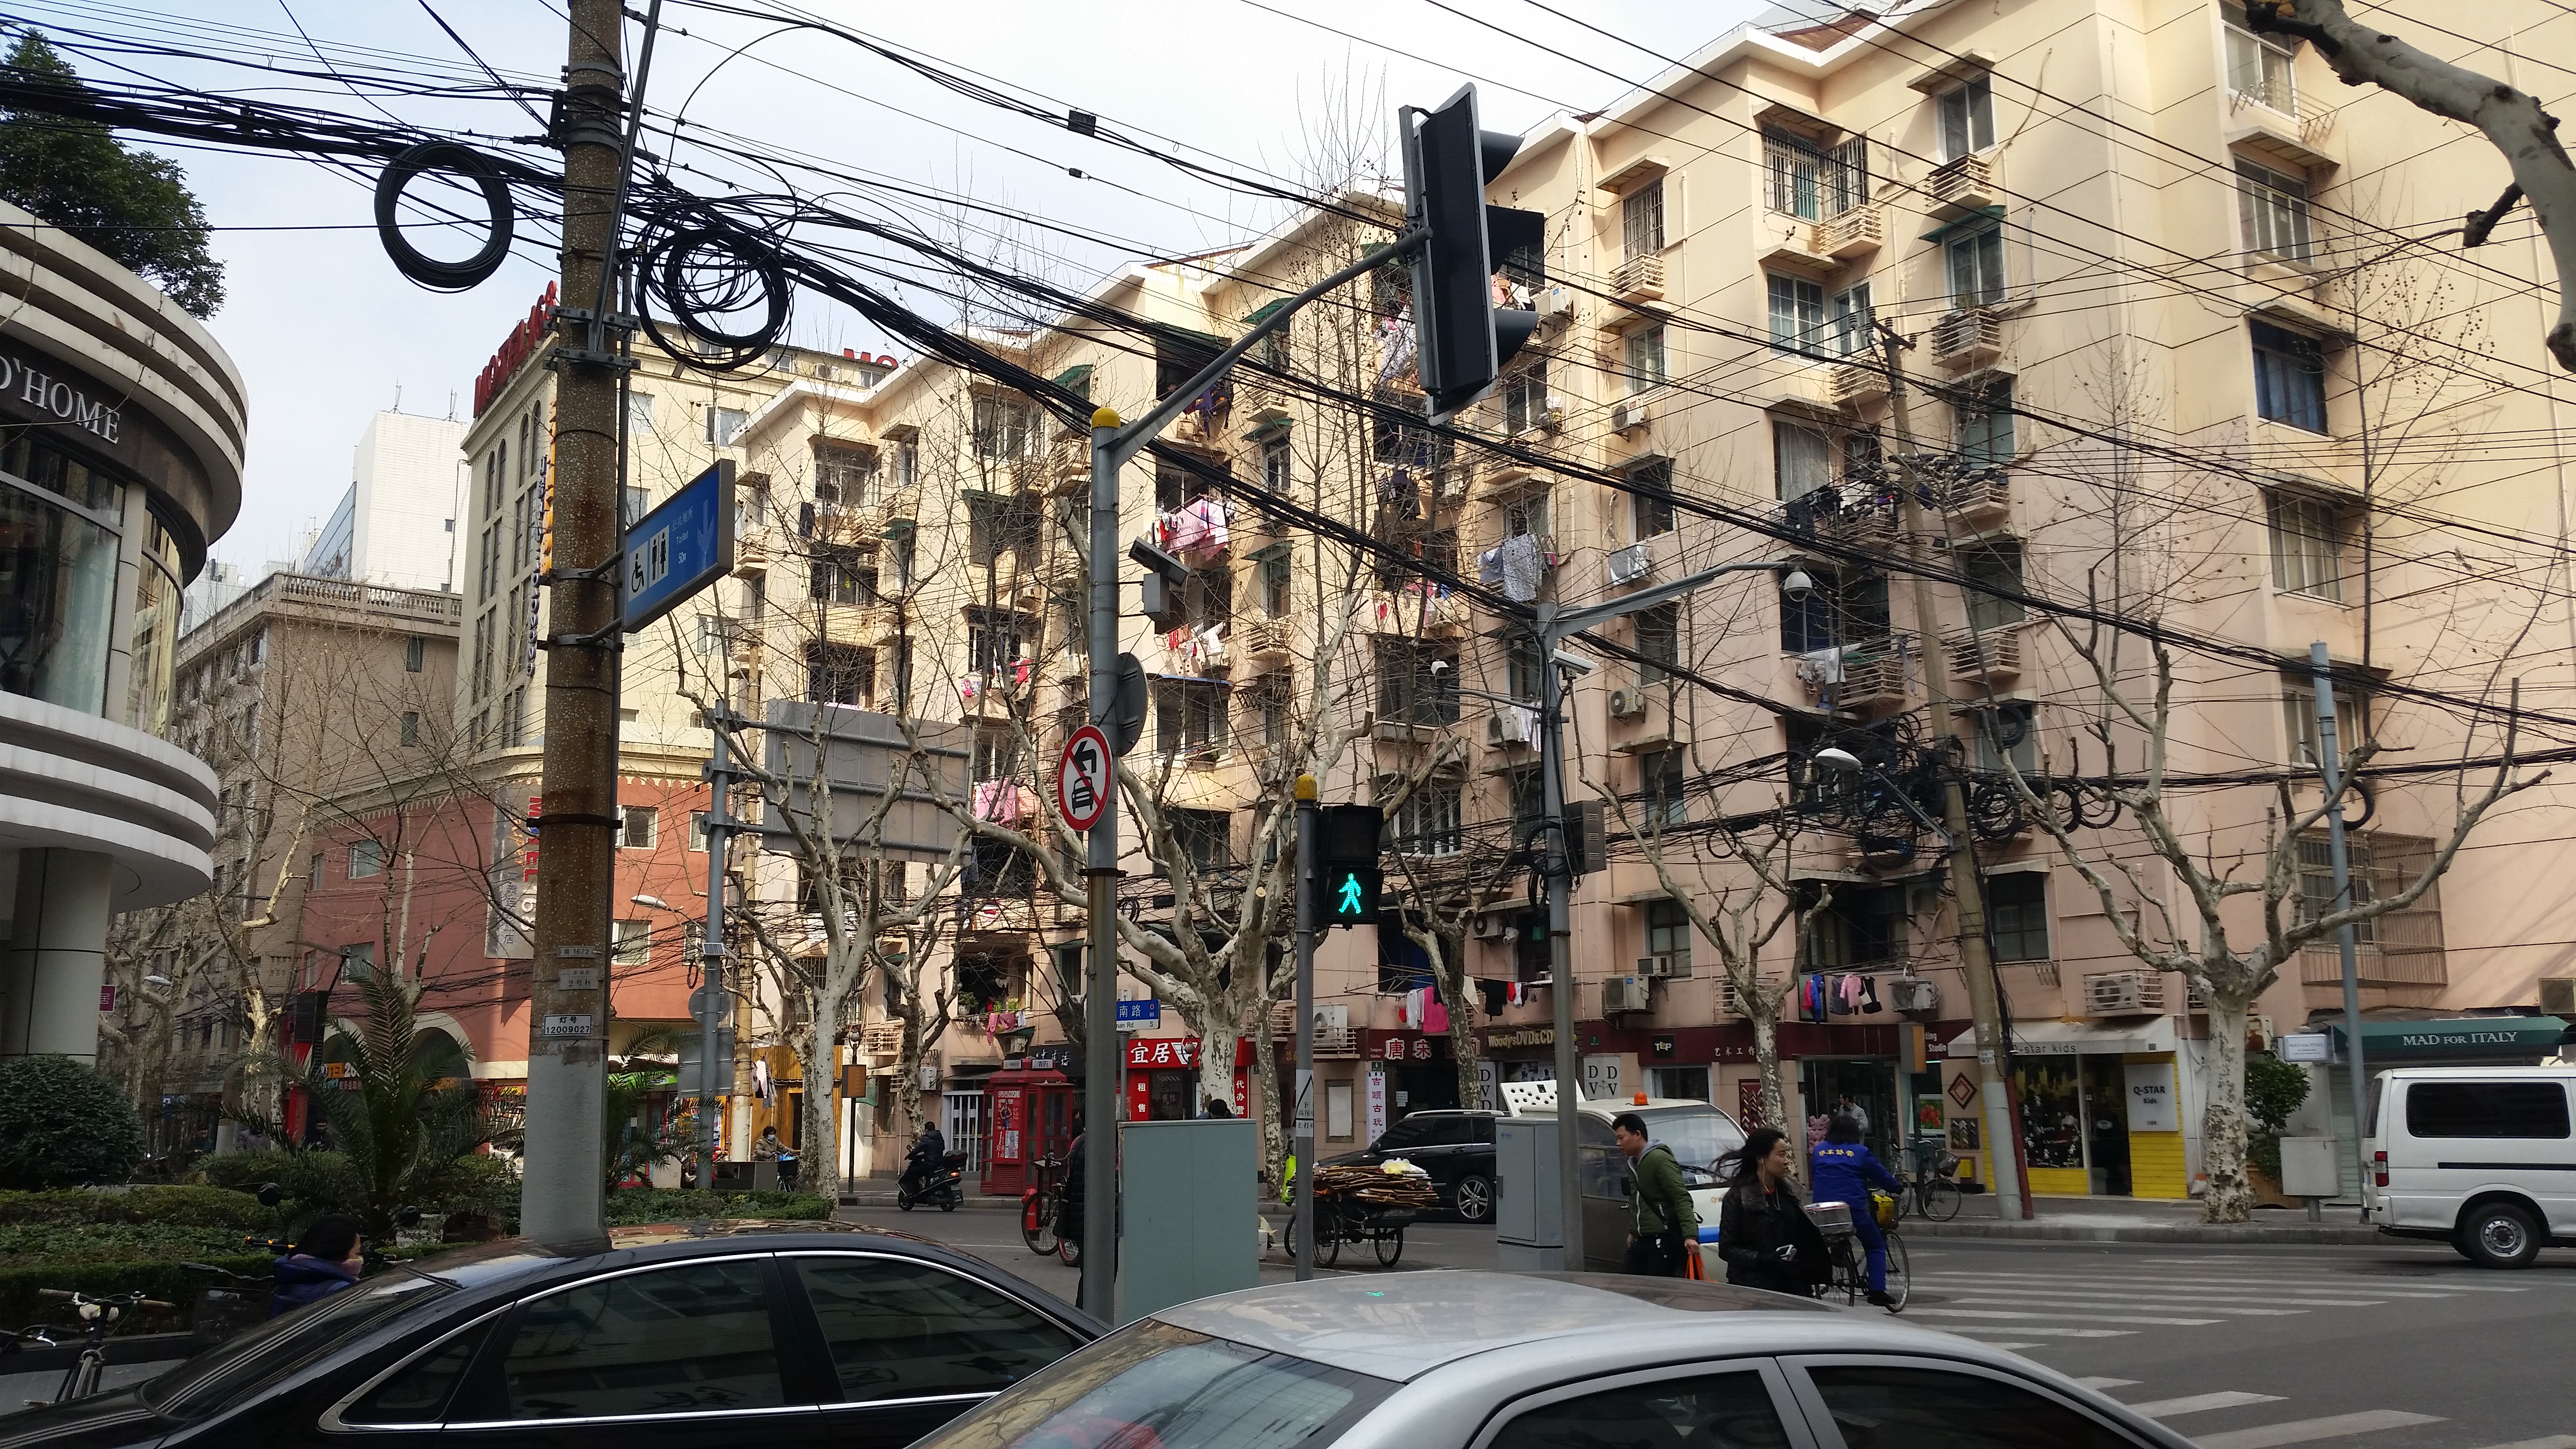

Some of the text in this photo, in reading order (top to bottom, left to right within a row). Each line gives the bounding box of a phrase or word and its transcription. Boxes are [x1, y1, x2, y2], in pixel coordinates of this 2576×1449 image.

[676, 531, 688, 545] Toilet
[1119, 1004, 1141, 1018] 南路
[2402, 1031, 2517, 1046] MAD FOR ITALY
[1130, 1042, 1170, 1063] 宜居
[2053, 1043, 2076, 1053] kids
[2134, 1086, 2165, 1095] Q-STAR
